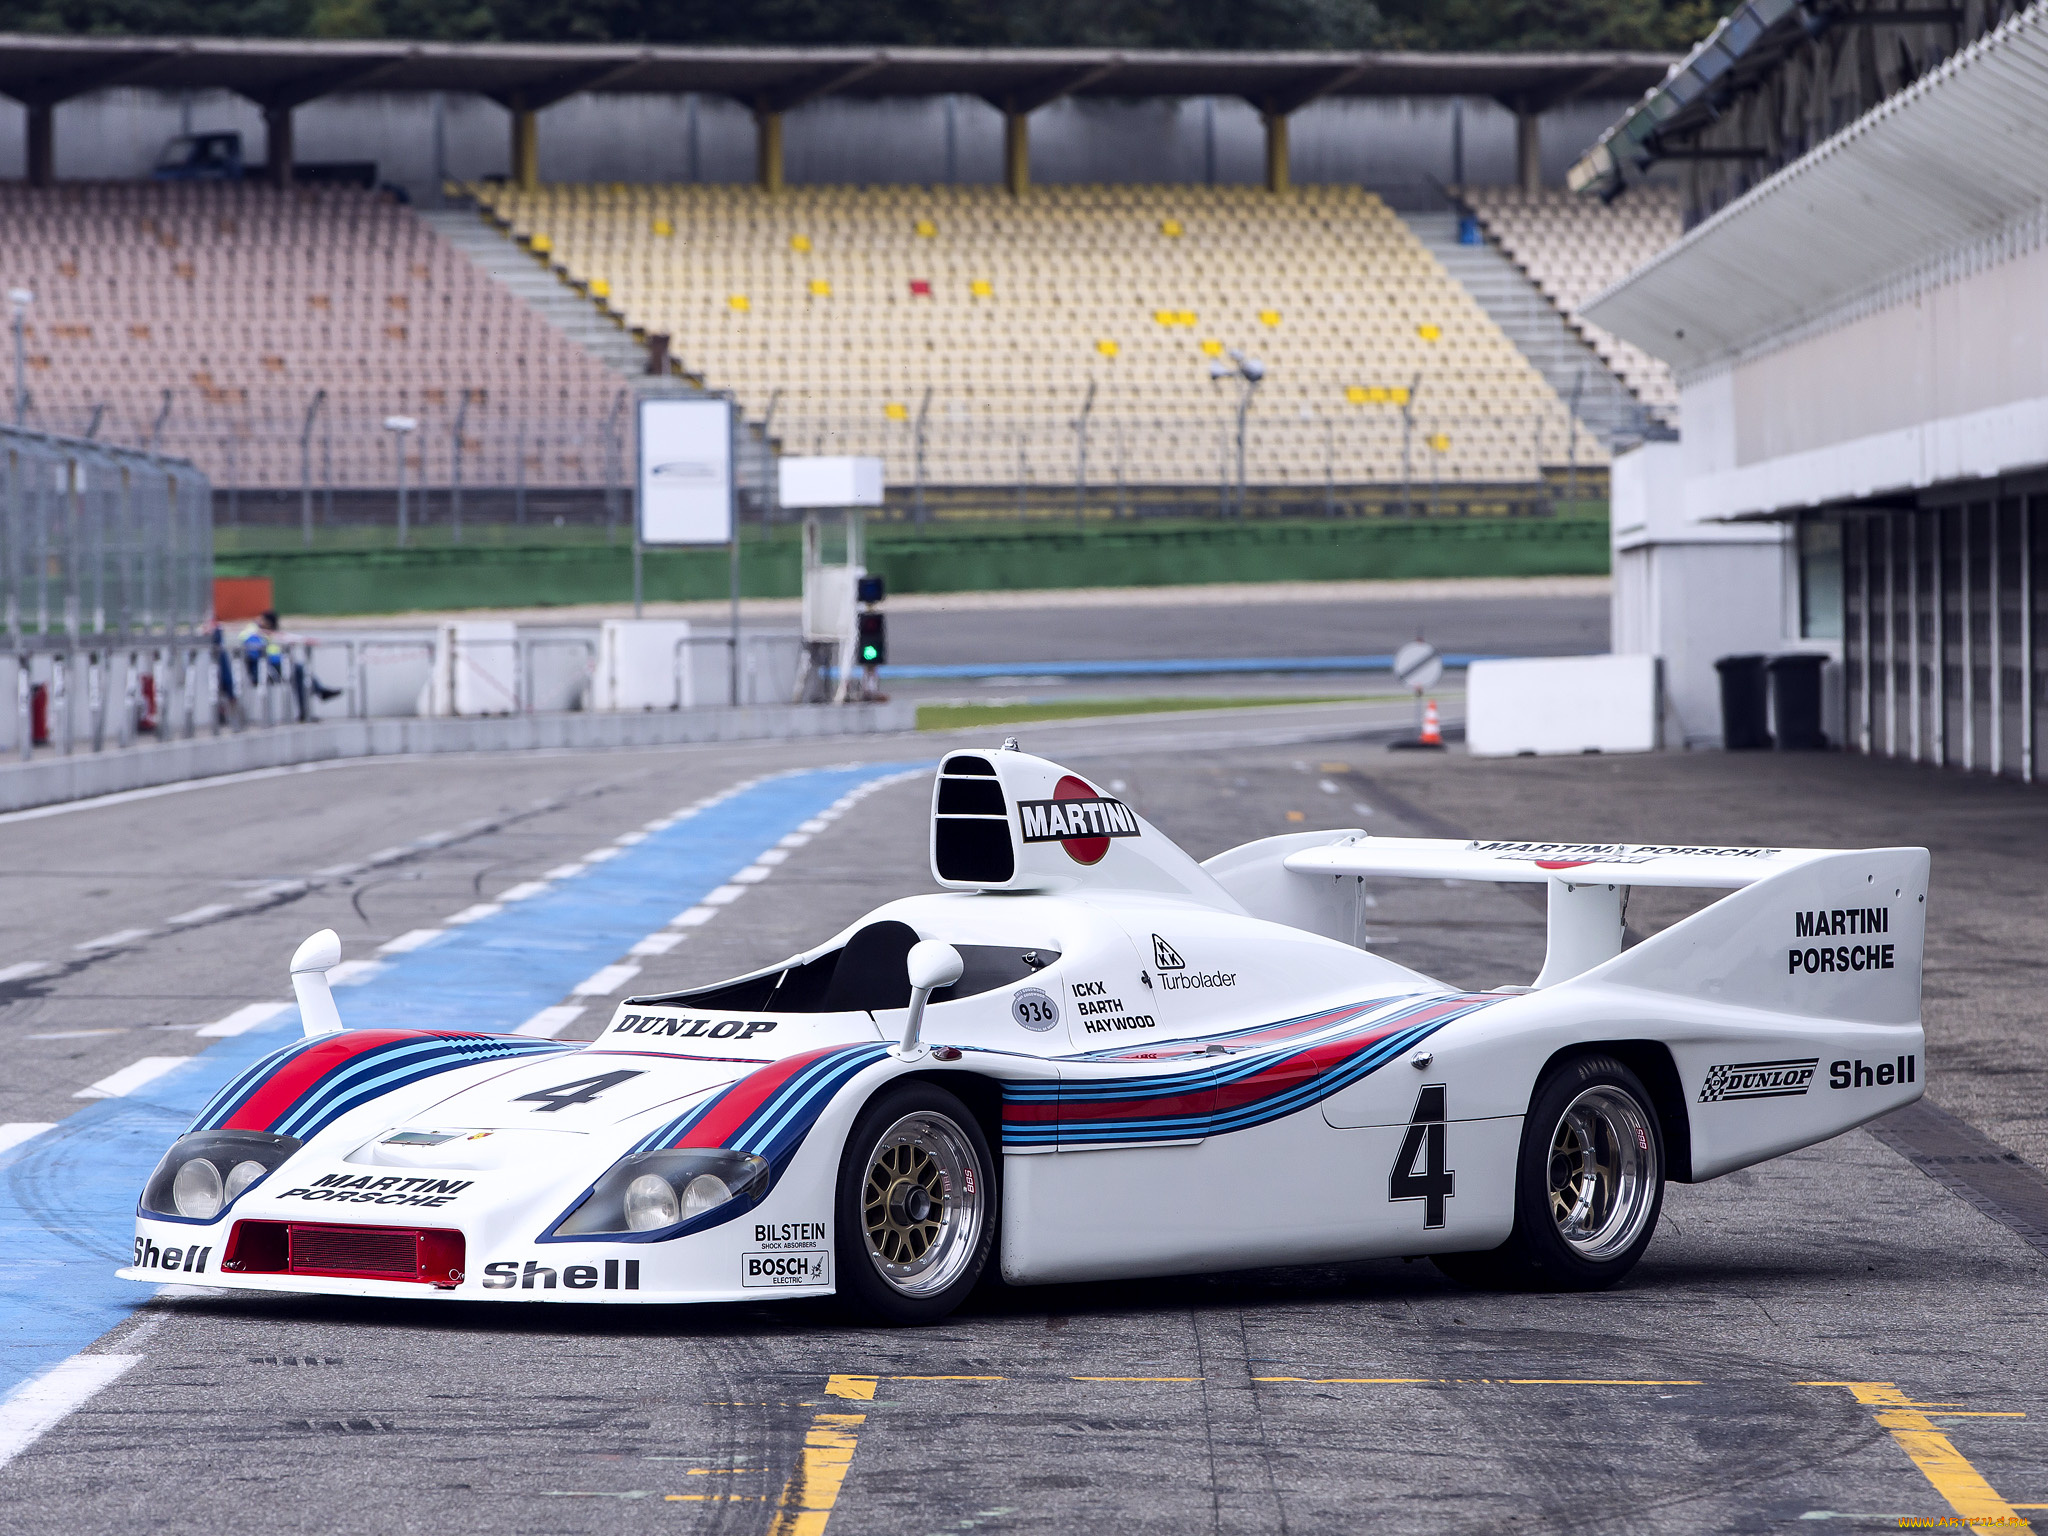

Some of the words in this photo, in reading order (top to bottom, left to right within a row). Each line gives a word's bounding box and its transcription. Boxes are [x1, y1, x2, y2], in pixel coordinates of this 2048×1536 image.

[1022, 802, 1136, 838] MARTINI
[1795, 907, 1889, 938] MARTINI
[1788, 944, 1895, 975] PORSCHE
[1072, 981, 1107, 997] ICKX
[1157, 971, 1237, 990] Turbolader
[1019, 1001, 1053, 1023] 936
[1077, 998, 1124, 1016] BARTH
[612, 1014, 778, 1040] DUNLOP
[1084, 1014, 1156, 1034] HAYWOOD
[1726, 1069, 1814, 1090] DUNLOP
[1829, 1055, 1916, 1090] Shell
[508, 1069, 651, 1113] 4
[1388, 1083, 1456, 1230] 4
[310, 1174, 475, 1195] MARTINI
[964, 1169, 975, 1194] BBS
[275, 1188, 458, 1208] PORSCHE
[755, 1222, 826, 1242] BILSTEIN
[134, 1236, 213, 1274] Shell
[761, 1242, 782, 1250] SHOCK
[783, 1241, 817, 1249] ABSORBERS
[482, 1259, 640, 1290] Shell
[749, 1257, 809, 1276] BOSCH
[772, 1276, 803, 1284] ELECTRIC
